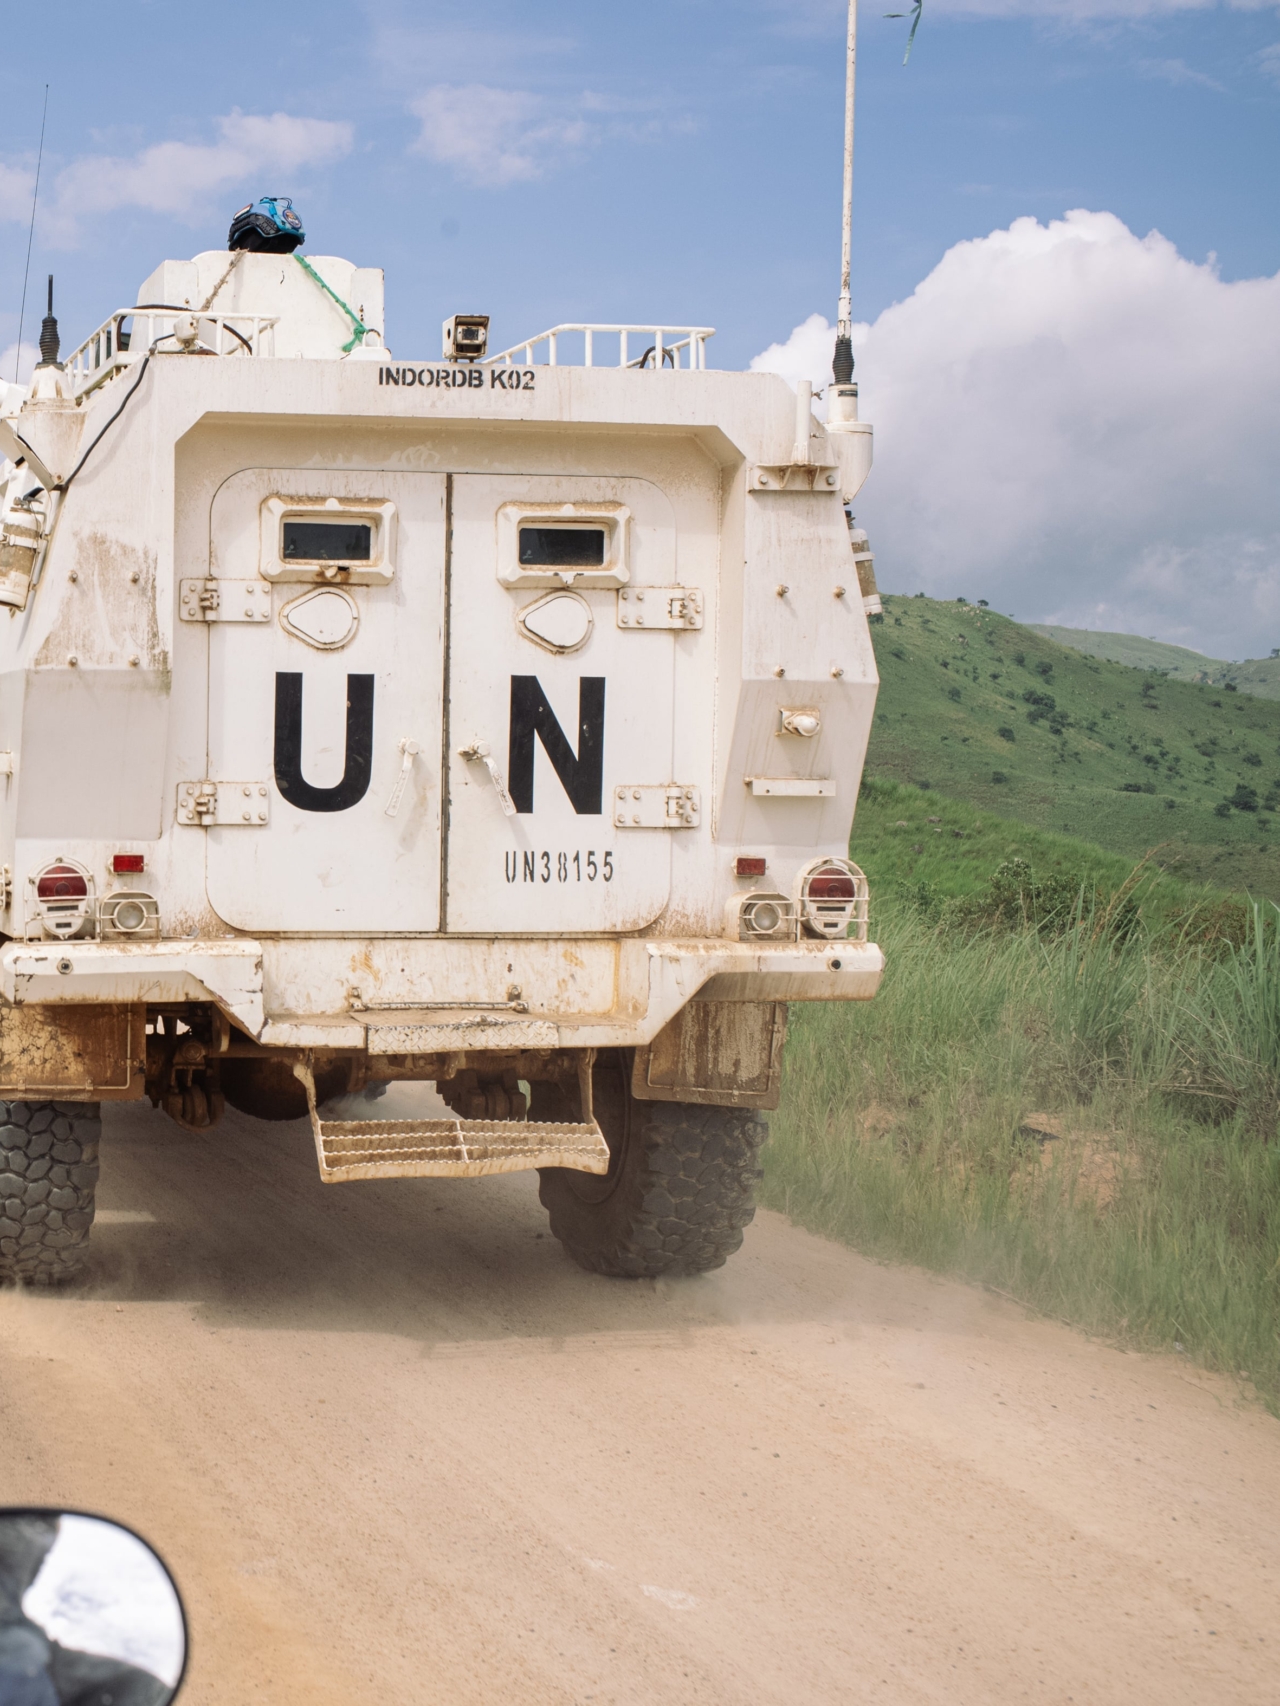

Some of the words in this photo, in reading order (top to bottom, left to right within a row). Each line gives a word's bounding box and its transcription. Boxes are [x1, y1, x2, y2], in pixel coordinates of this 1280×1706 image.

[378, 366, 484, 390] INDORDB
[490, 369, 536, 391] K02
[505, 849, 615, 884] UN38155
